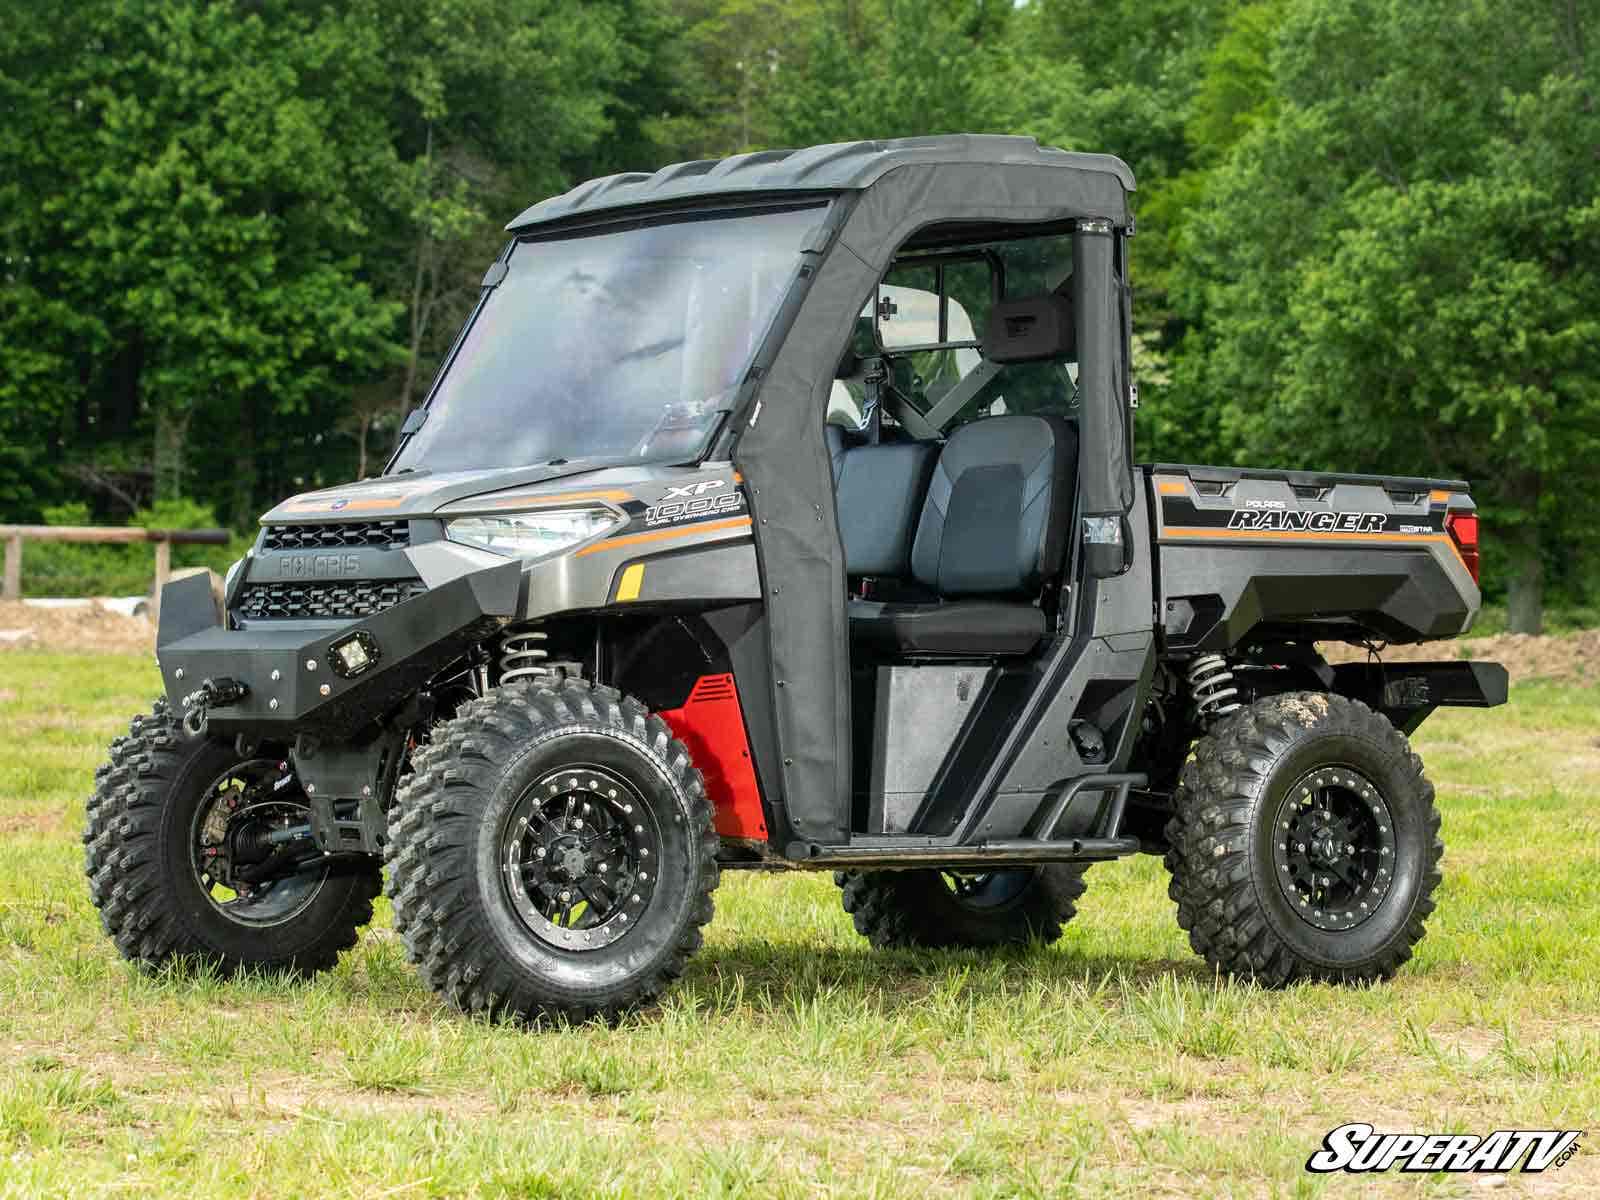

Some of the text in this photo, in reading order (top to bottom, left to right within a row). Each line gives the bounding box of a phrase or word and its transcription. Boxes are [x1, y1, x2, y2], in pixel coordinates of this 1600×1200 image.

[660, 479, 725, 500] XP
[645, 492, 742, 522] 1000
[1245, 499, 1286, 509] POLARIS
[1227, 509, 1388, 533] RANGER
